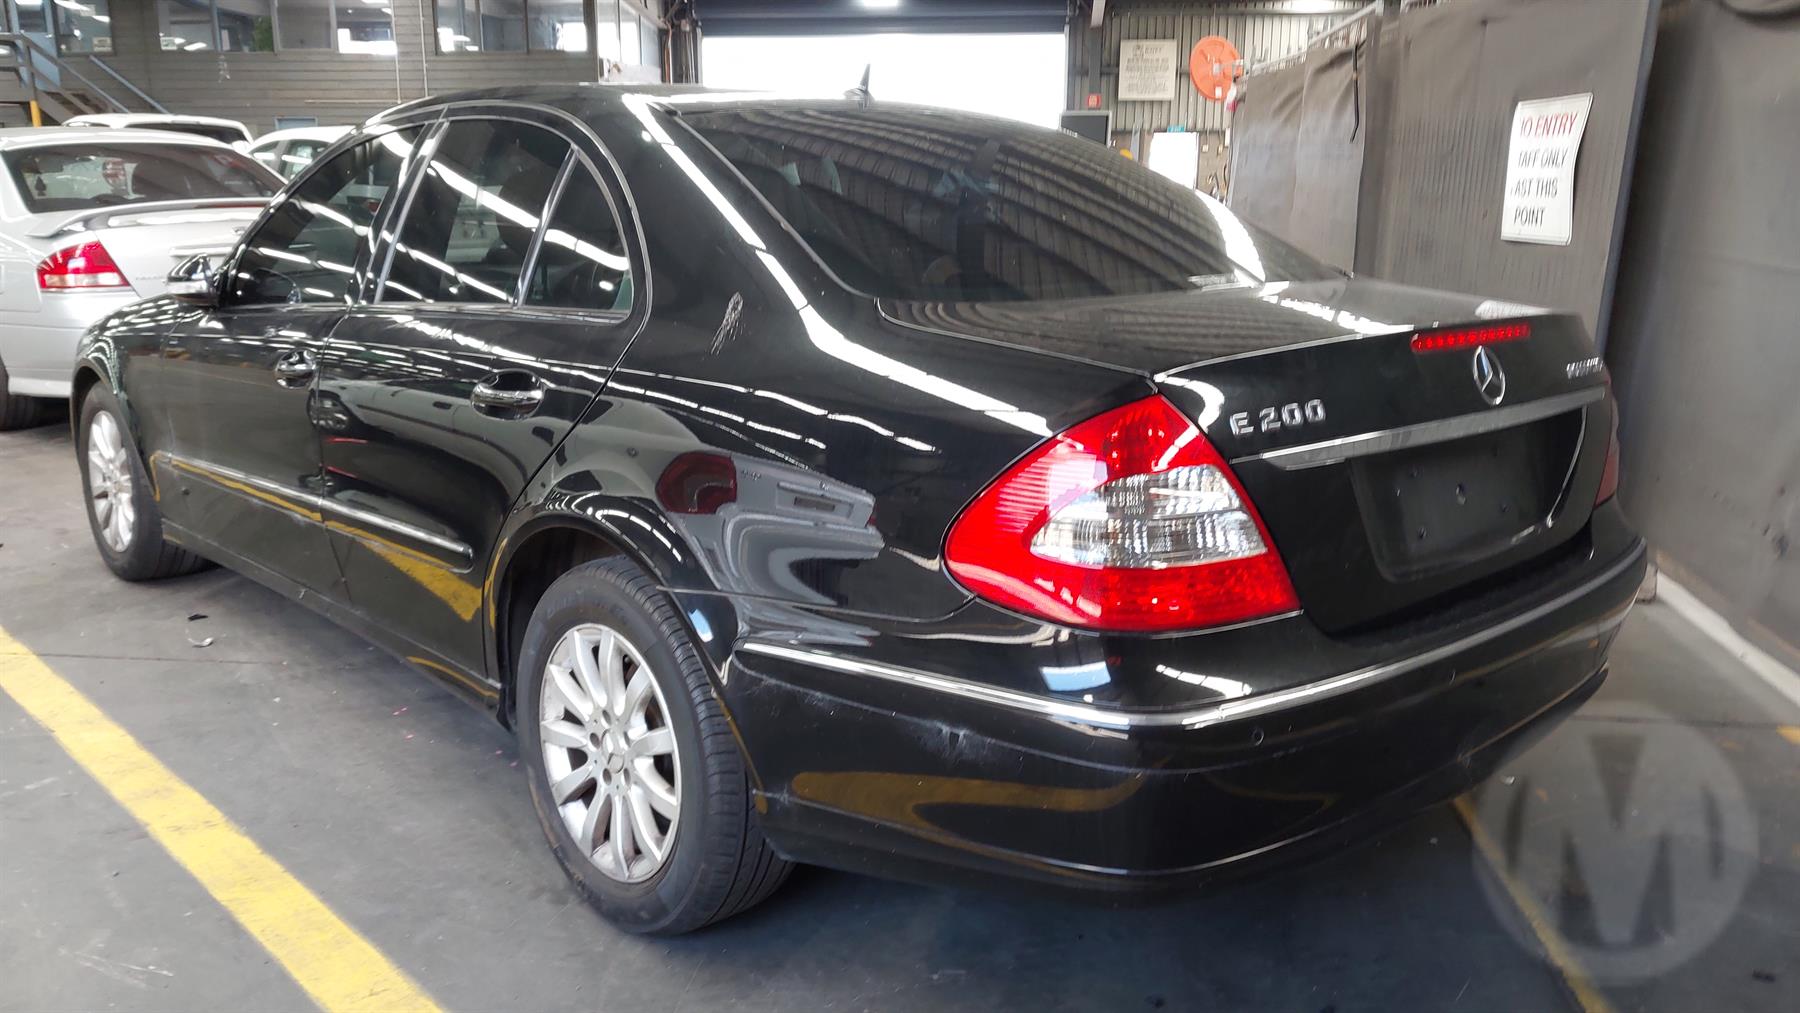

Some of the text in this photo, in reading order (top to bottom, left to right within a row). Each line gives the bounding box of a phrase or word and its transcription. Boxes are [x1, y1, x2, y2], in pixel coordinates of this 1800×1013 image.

[1534, 111, 1578, 138] ENTRY
[1516, 146, 1569, 169] TAFF ONLY
[1535, 176, 1558, 199] THIS
[1513, 205, 1546, 228] POINT
[1229, 398, 1326, 436] E 200
